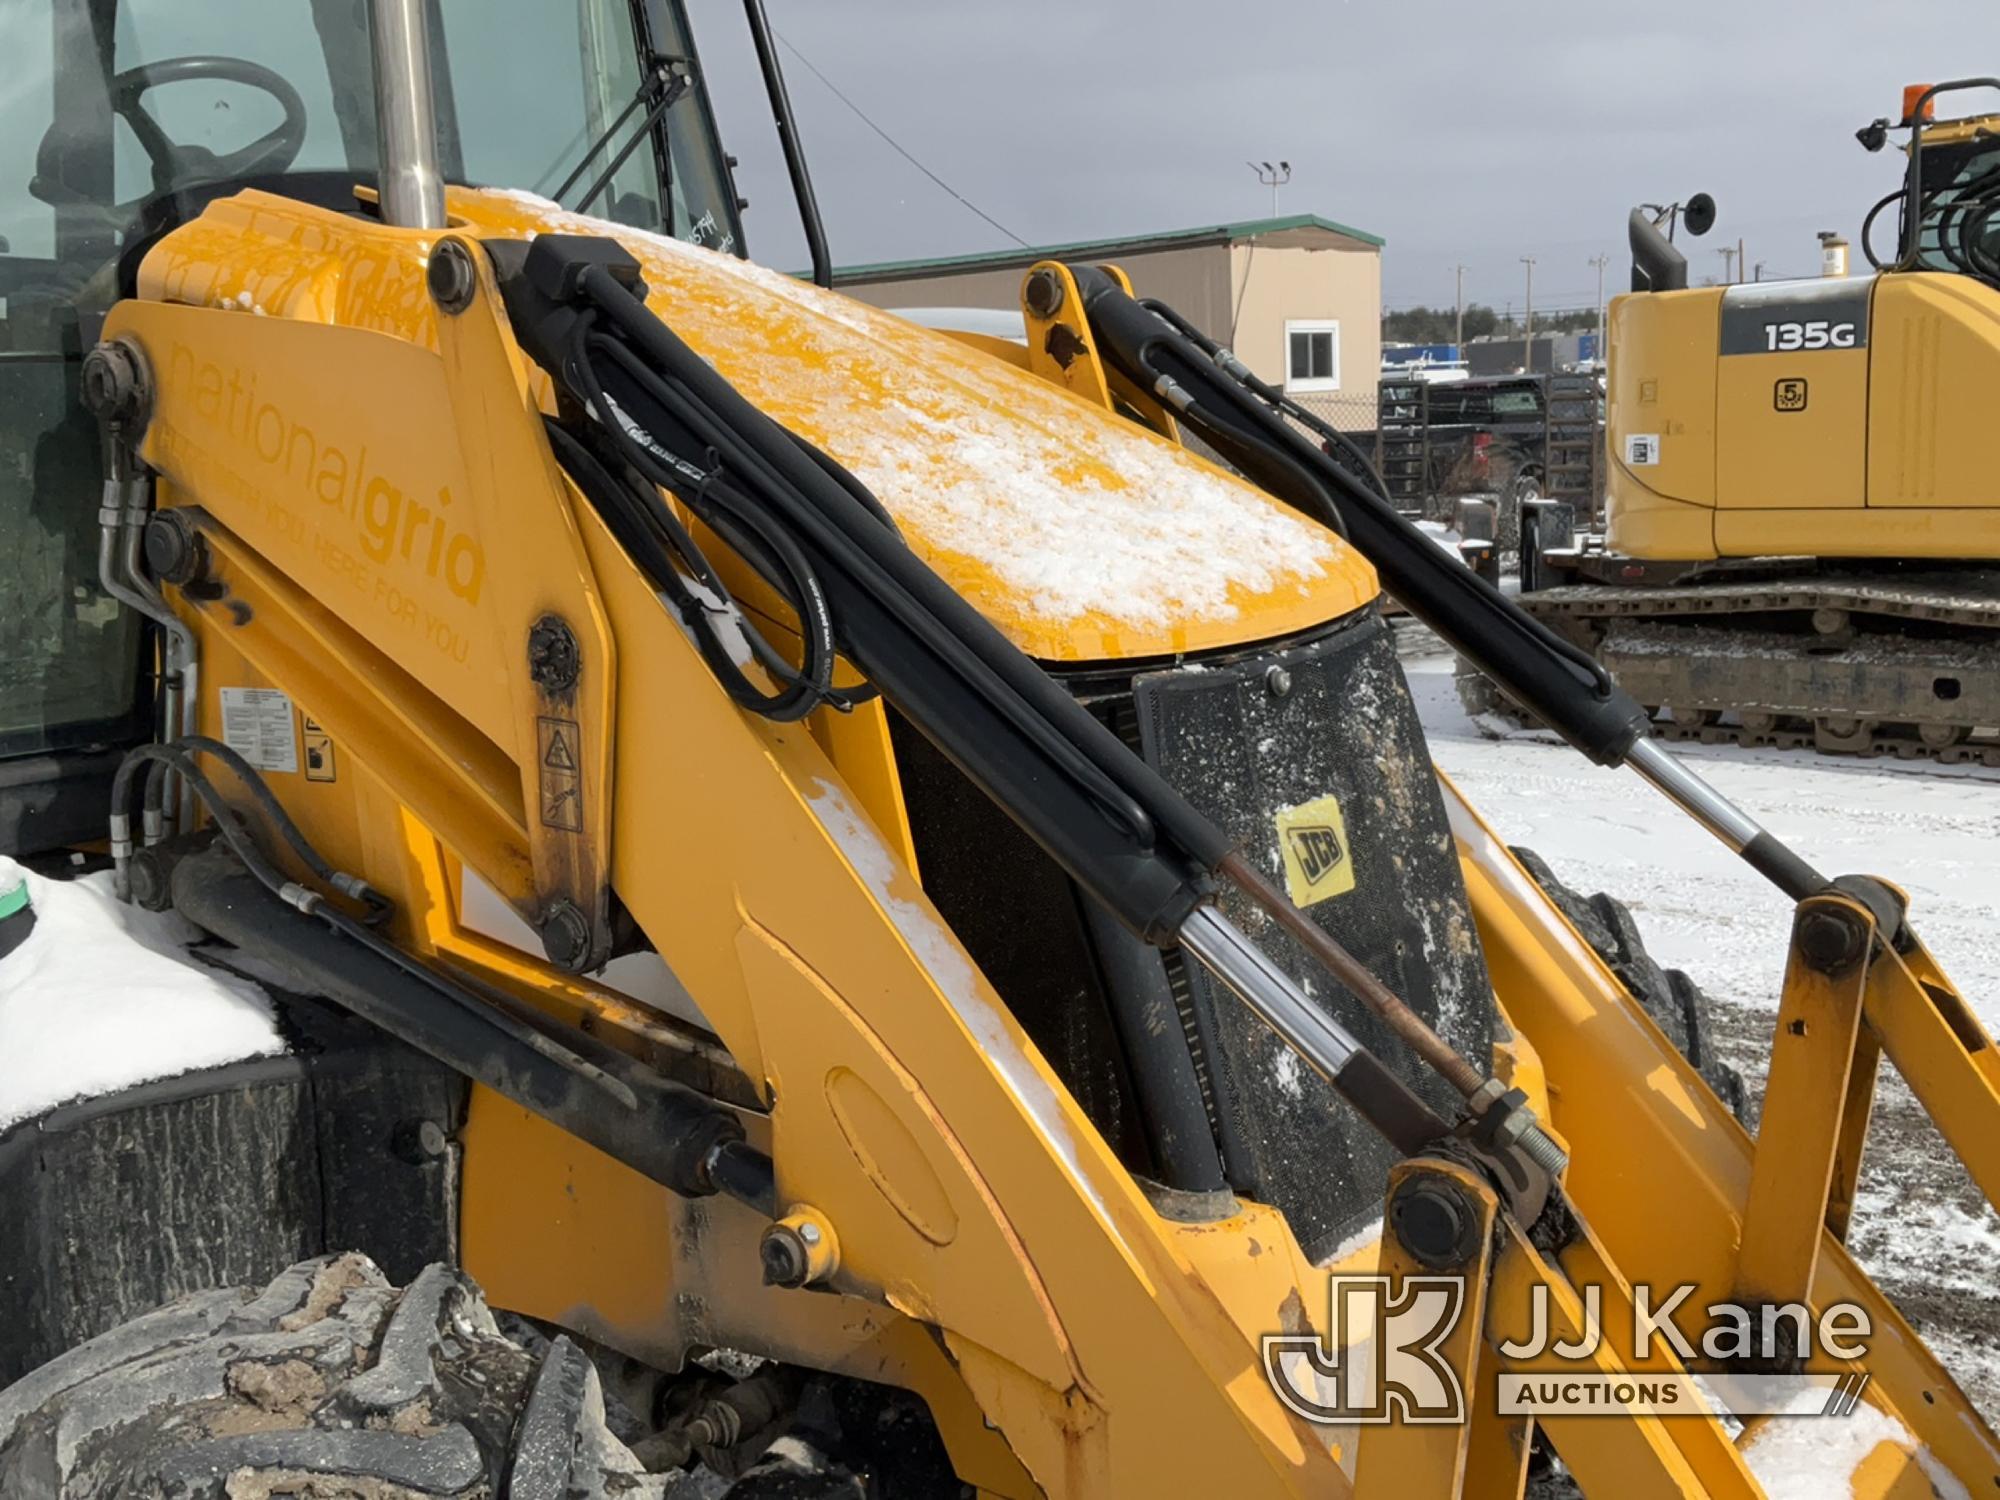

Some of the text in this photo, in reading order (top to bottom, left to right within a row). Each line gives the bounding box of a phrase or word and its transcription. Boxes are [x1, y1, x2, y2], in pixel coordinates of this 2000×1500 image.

[1765, 321, 1855, 351] 135G
[313, 532, 369, 594] HERE
[374, 575, 419, 627] FOR
[1297, 829, 1340, 878] JCB
